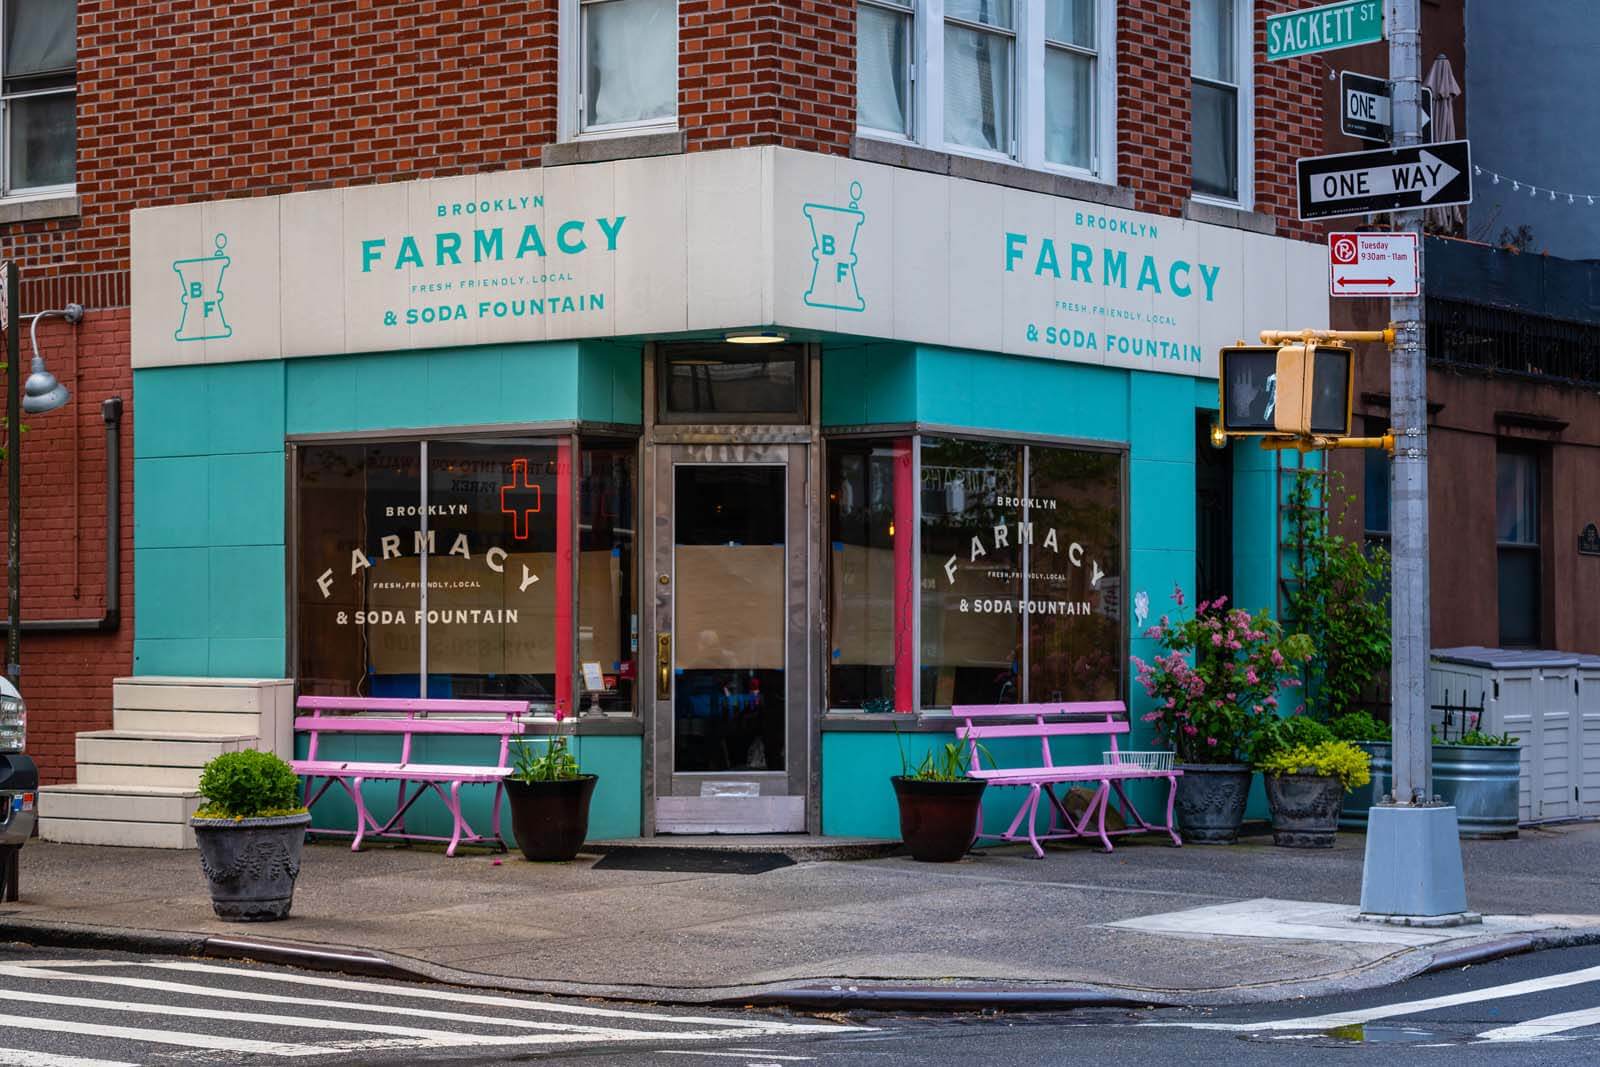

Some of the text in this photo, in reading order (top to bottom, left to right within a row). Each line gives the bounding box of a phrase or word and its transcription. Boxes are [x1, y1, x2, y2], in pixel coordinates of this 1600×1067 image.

[1270, 4, 1376, 55] SACKETT ST
[1350, 93, 1376, 120] ONE
[1323, 163, 1442, 198] ONE WAY
[437, 196, 544, 217] BROOKLYN
[1075, 211, 1158, 239] BROOKLYN
[361, 216, 626, 273] FARMACY
[820, 234, 836, 256] B
[1361, 241, 1388, 250] Tuesday
[835, 262, 850, 283] F
[1005, 232, 1220, 302] FARMACY
[190, 281, 202, 298] B
[203, 301, 215, 318] F
[384, 293, 605, 326] & SODA FOUNTAIN
[1026, 323, 1201, 363] & SODA FOUNTAIN
[386, 503, 468, 517] BROOKLYN
[997, 496, 1056, 510] BROOKLYN
[316, 530, 540, 598] FARMACY
[944, 521, 1105, 586] FARMACY
[336, 609, 519, 626] & SODA FOUNTAIN
[959, 599, 969, 613] &
[974, 599, 1012, 613] SODA
[1018, 600, 1091, 616] FOUNTAIN
